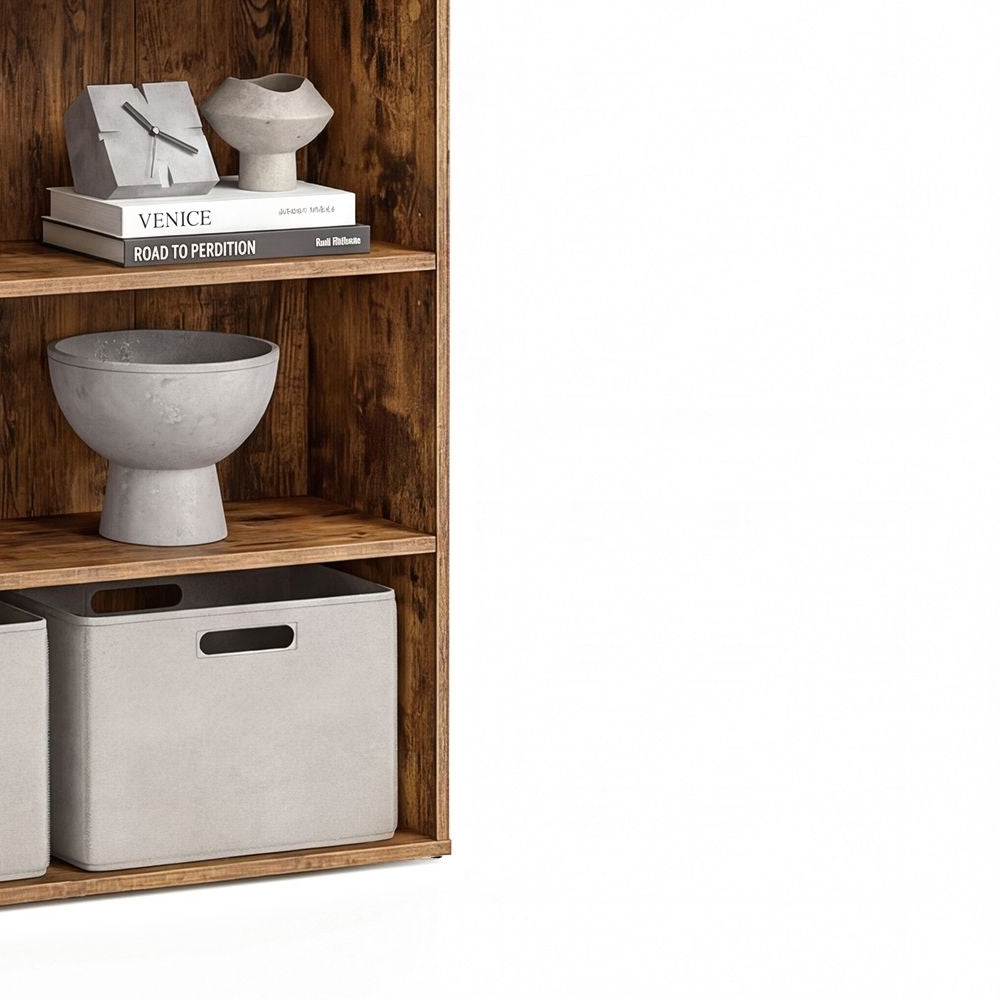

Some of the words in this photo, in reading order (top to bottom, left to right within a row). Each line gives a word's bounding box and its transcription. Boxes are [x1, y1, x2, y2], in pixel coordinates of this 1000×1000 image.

[138, 209, 212, 229] VENICE
[134, 245, 169, 262] ROAD
[171, 243, 188, 260] TO
[191, 239, 256, 259] PERDITION
